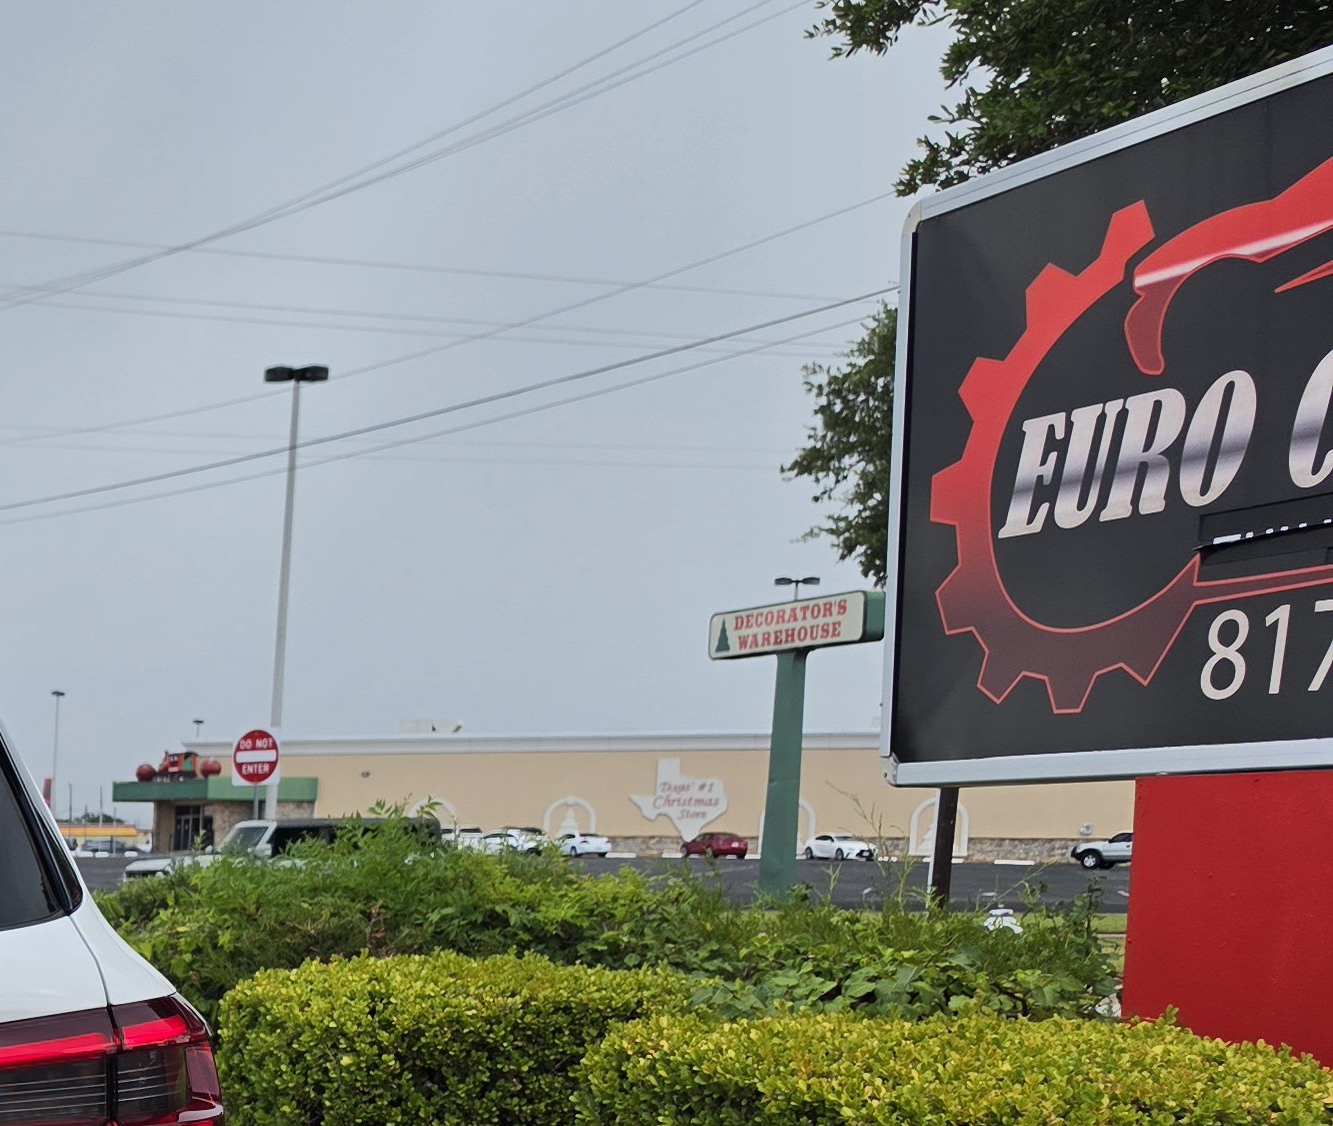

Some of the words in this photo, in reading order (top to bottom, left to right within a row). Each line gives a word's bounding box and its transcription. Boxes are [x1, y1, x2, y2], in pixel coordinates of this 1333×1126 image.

[998, 370, 1257, 539] EURO
[734, 599, 848, 631] DECORATOR'S
[738, 621, 842, 650] WAREHOUSE
[239, 738, 252, 750] DO
[255, 737, 273, 749] NOT
[242, 763, 270, 775] ENTER
[698, 782, 714, 793] #1
[653, 794, 720, 809] Christmas
[677, 809, 707, 820] Store
